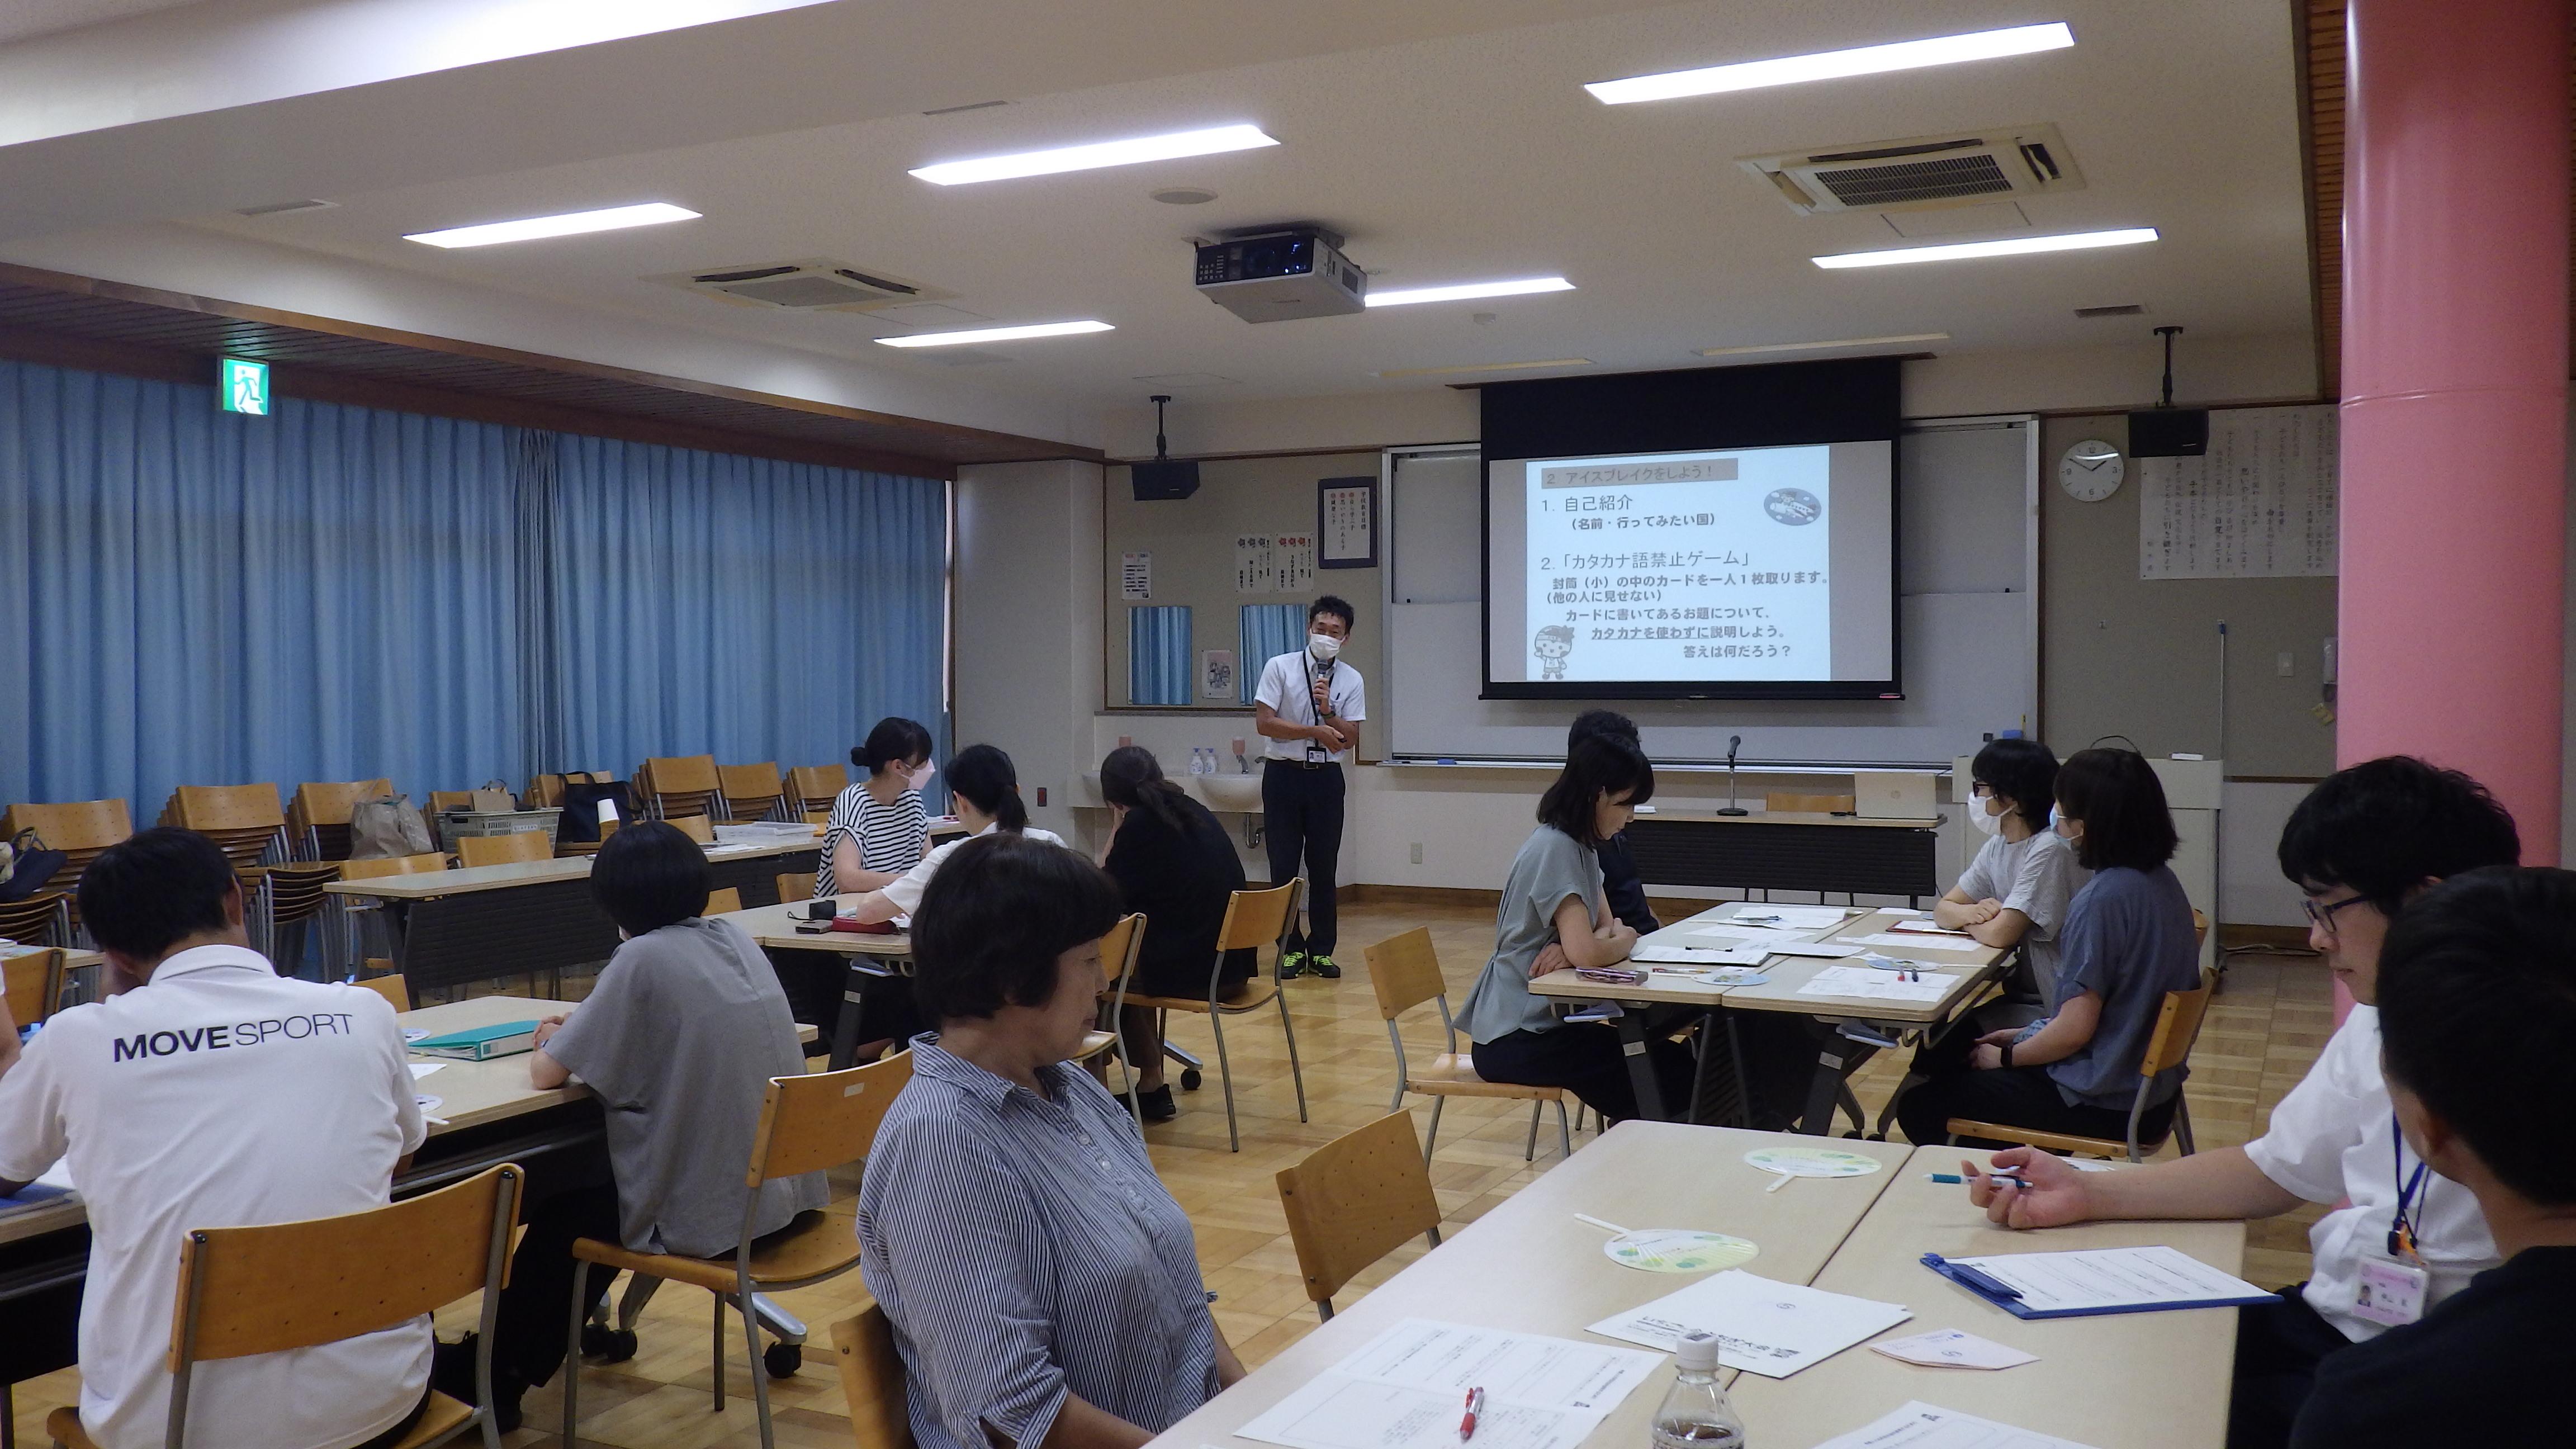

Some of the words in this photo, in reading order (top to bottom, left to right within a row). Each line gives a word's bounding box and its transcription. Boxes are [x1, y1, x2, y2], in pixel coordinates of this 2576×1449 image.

[1565, 494, 1633, 512] 自己紹介
[1591, 625, 1784, 640] カタカナを使わずに説明しよう。
[1683, 645, 1791, 658] 答えは何だろう？
